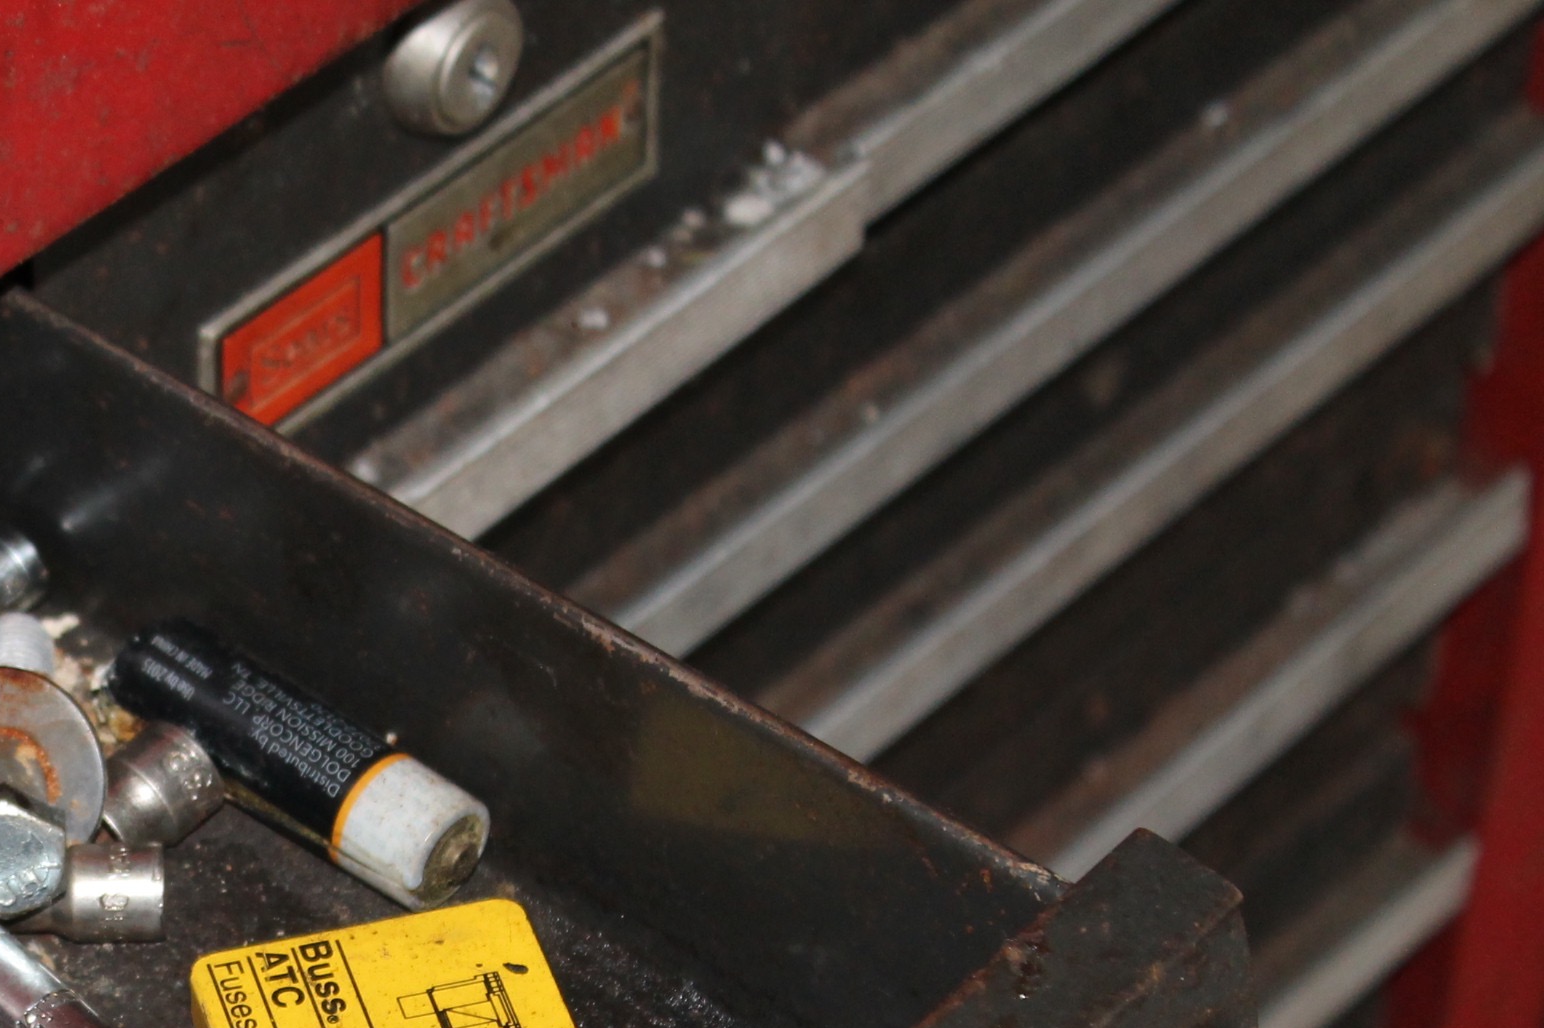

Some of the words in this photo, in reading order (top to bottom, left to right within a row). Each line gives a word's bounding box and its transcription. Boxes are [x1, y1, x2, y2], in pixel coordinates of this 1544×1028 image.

[221, 691, 250, 715] LLC
[275, 707, 337, 752] MISSION
[266, 740, 341, 798] Distributed
[334, 747, 360, 768] 100
[254, 951, 305, 1008] ATC
